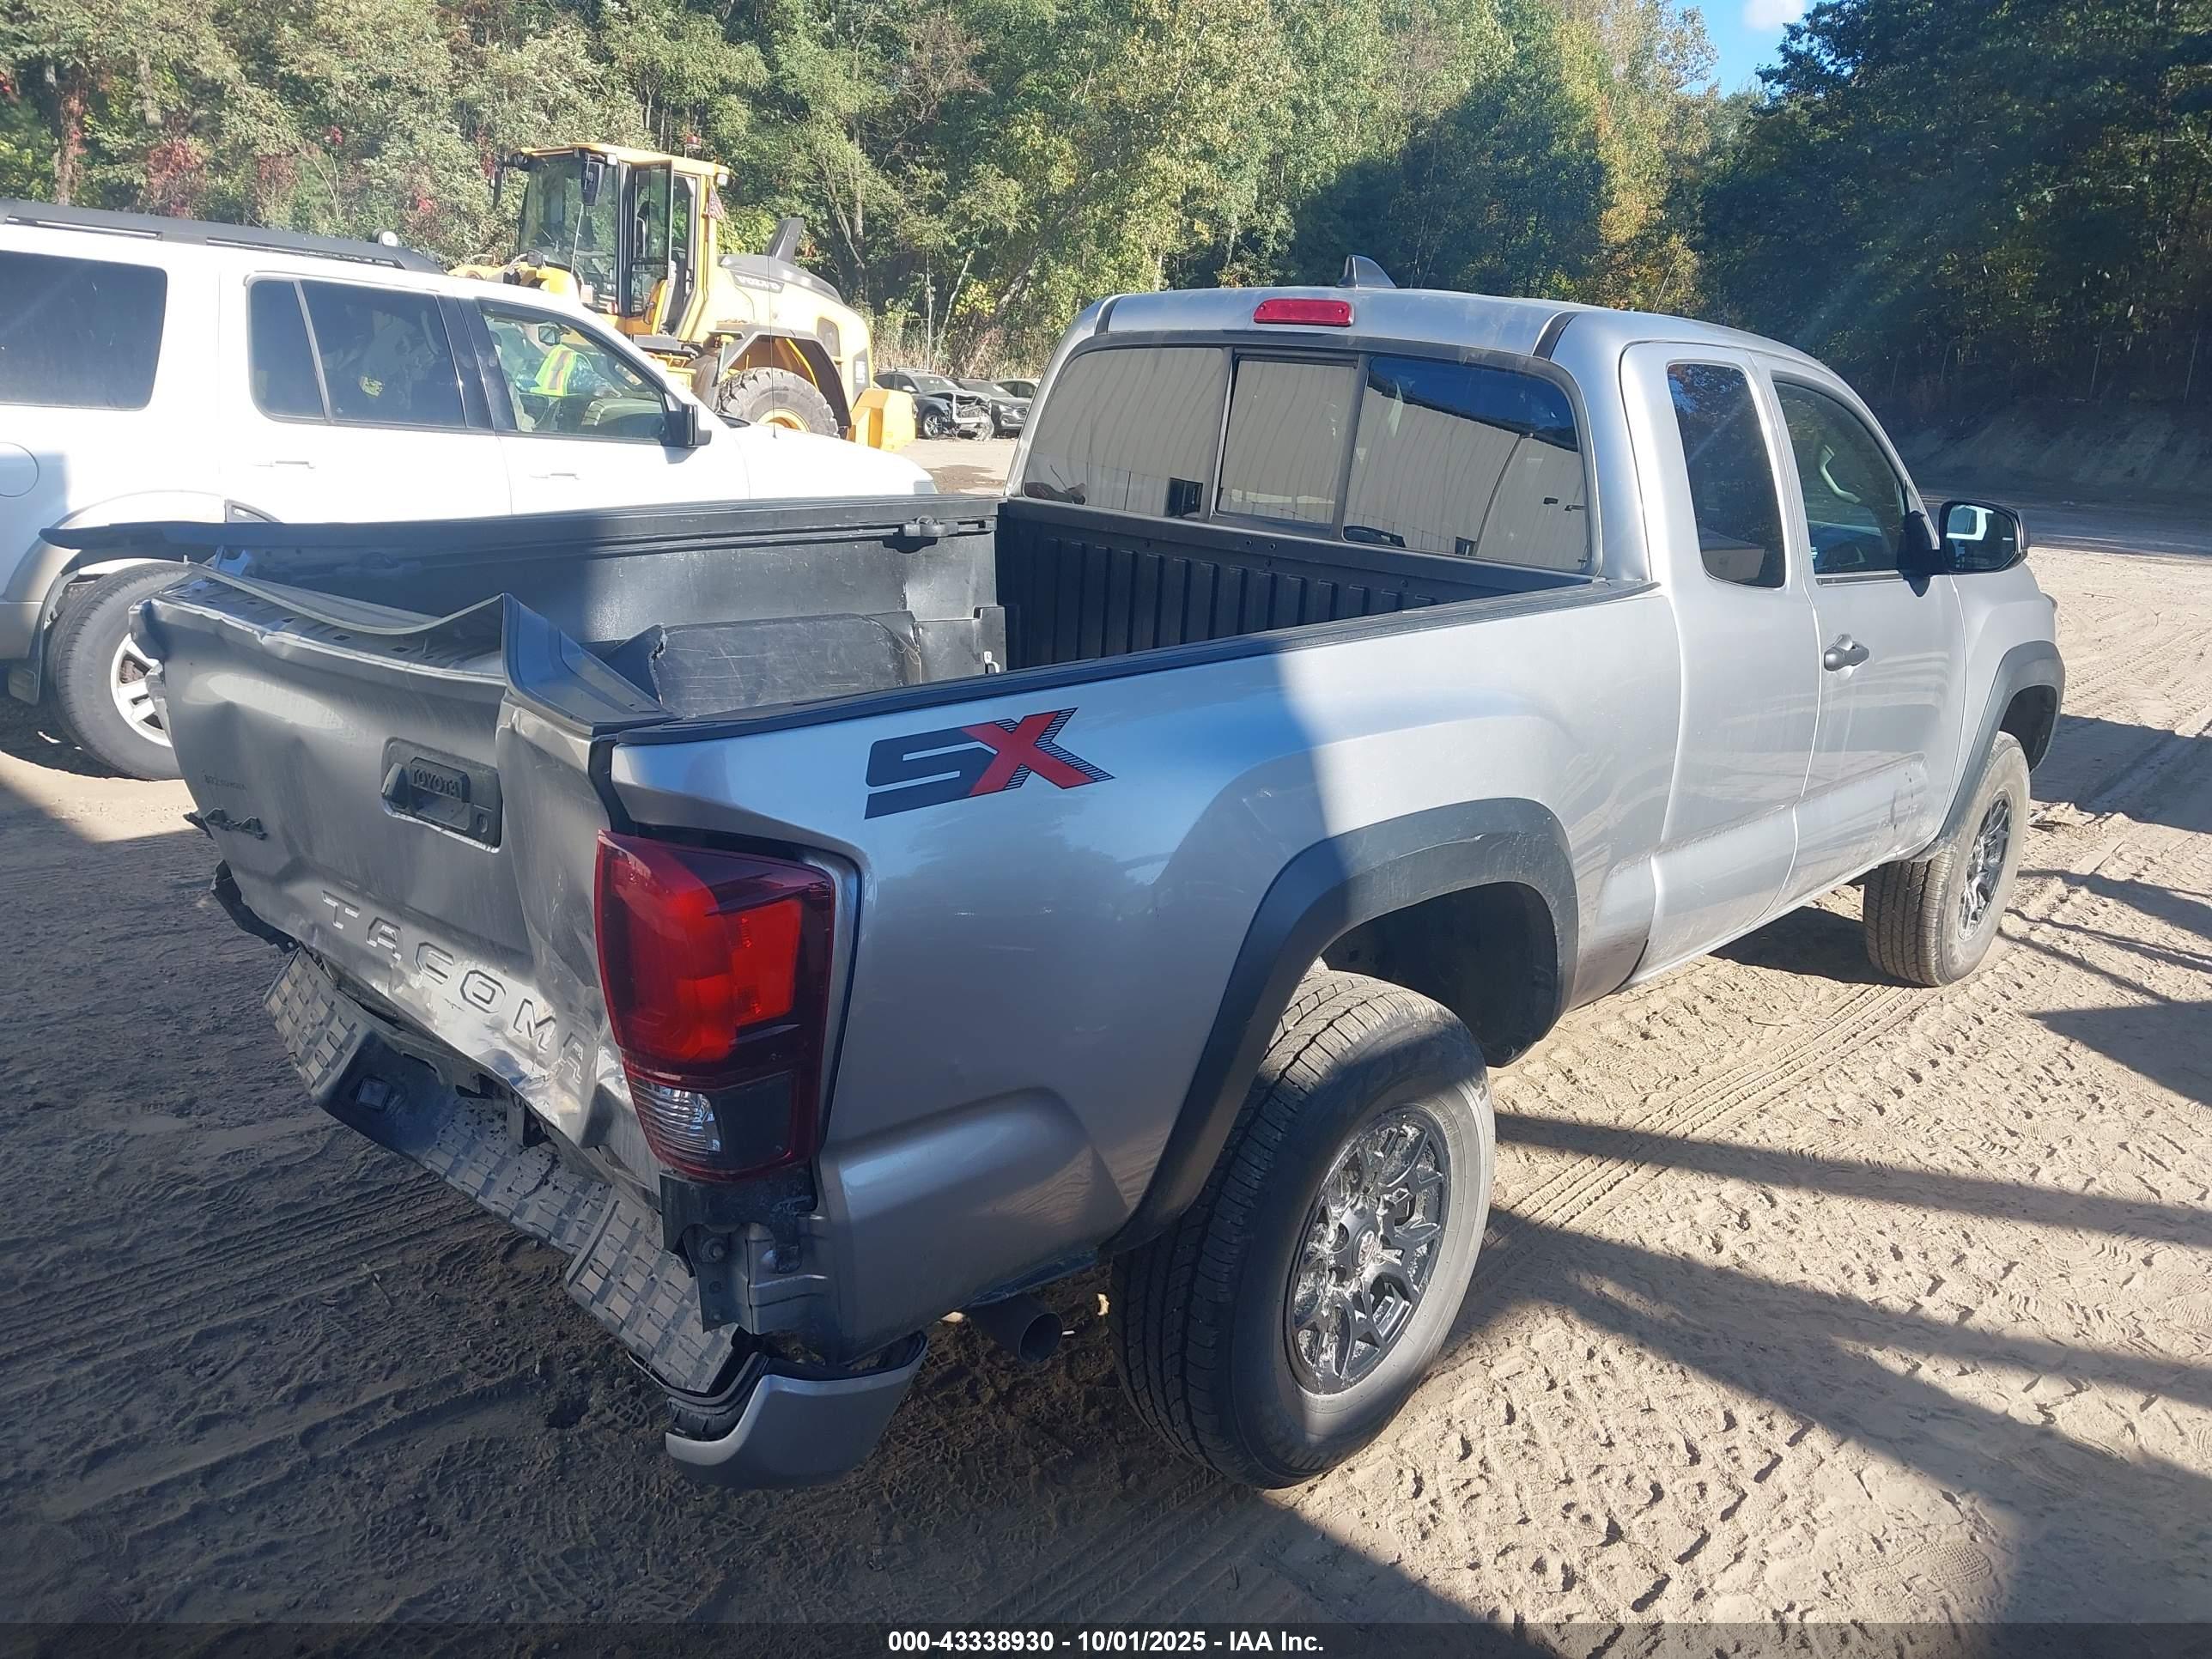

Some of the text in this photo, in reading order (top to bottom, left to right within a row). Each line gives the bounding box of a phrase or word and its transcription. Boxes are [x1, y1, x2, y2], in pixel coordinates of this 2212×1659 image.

[734, 274, 781, 290] VOLVO
[412, 769, 461, 799] TOYOTA
[865, 707, 1115, 820] SX
[322, 890, 586, 1084] TACOMA
